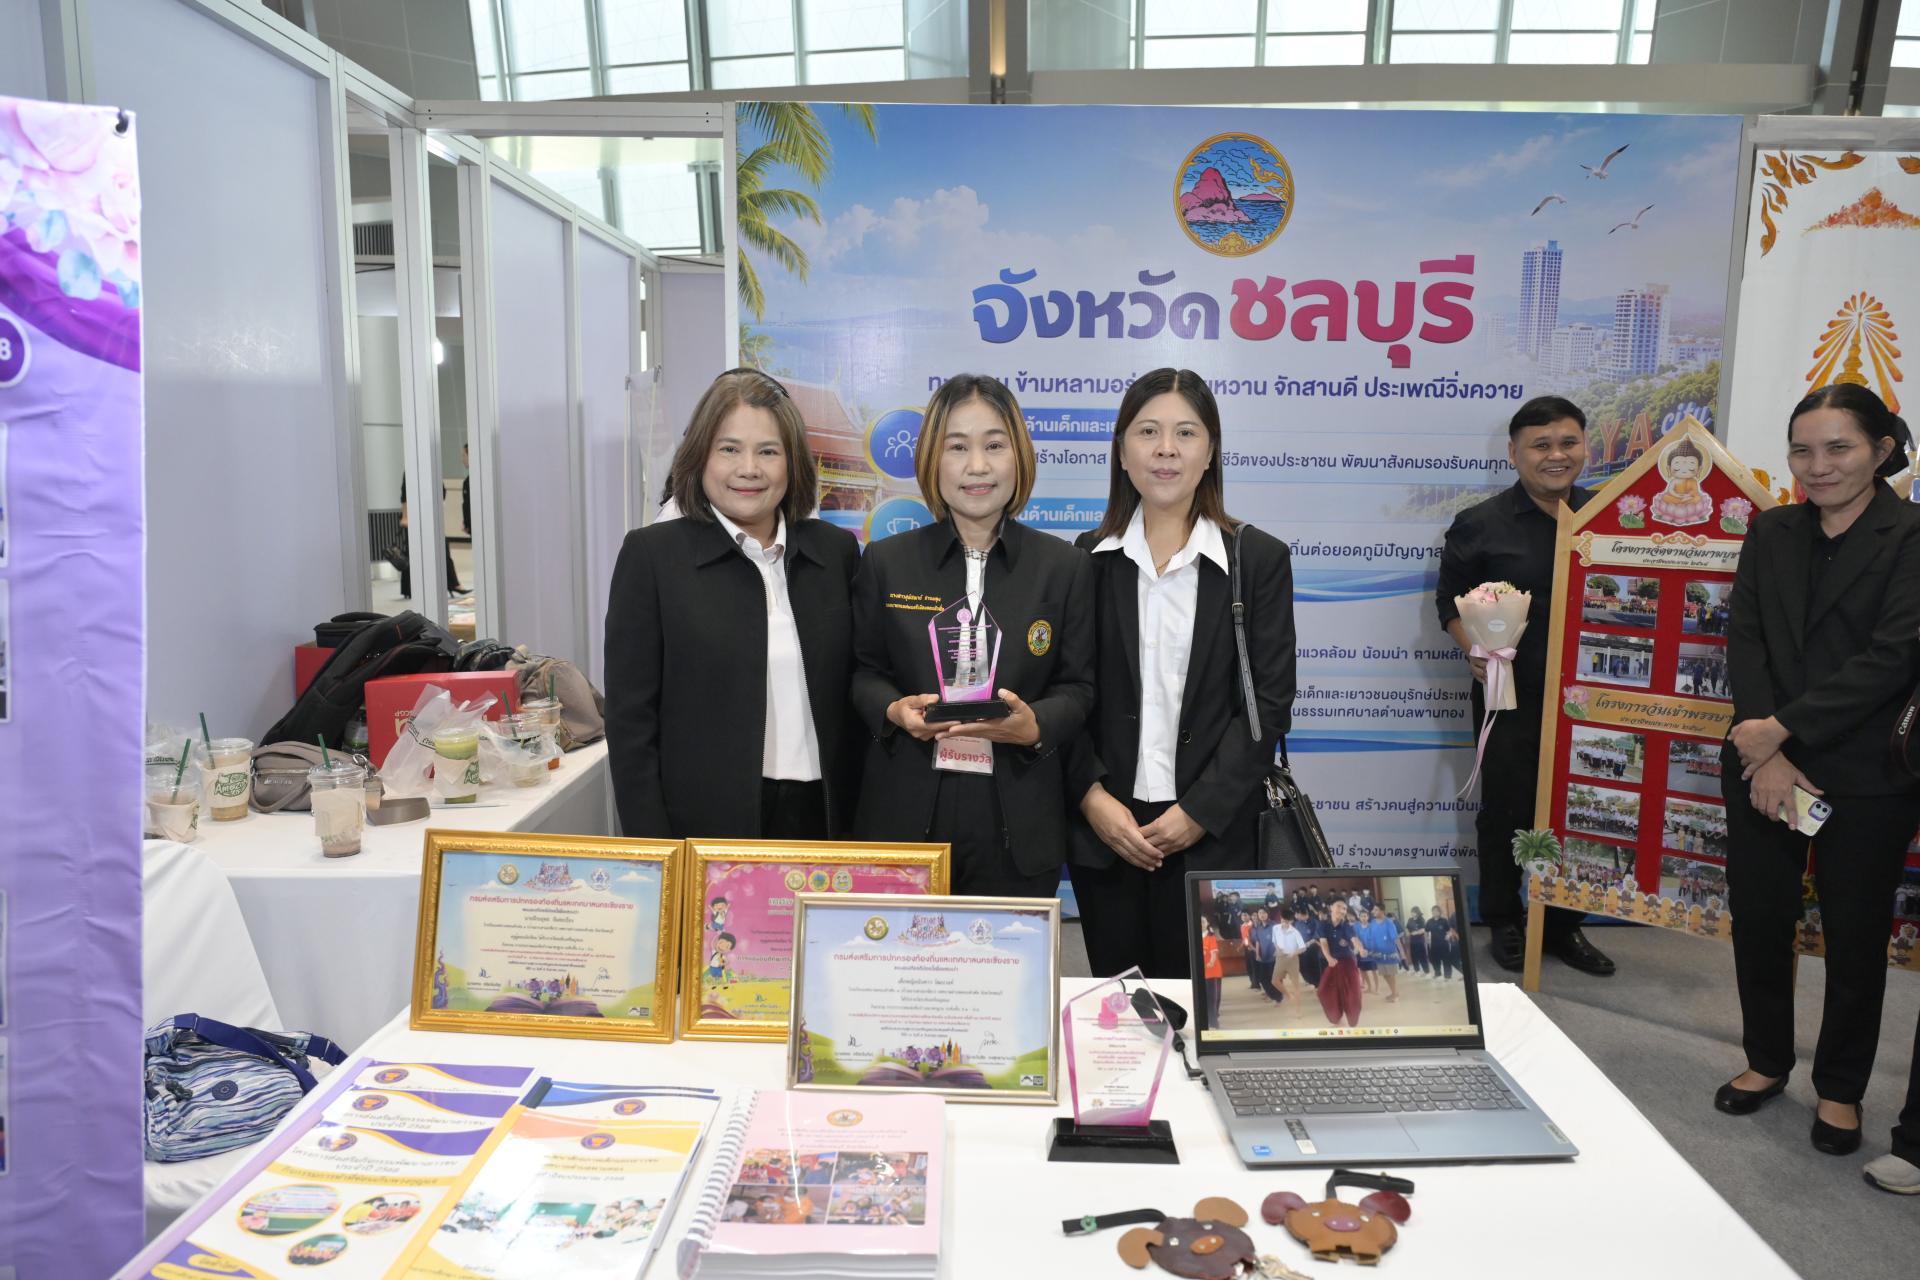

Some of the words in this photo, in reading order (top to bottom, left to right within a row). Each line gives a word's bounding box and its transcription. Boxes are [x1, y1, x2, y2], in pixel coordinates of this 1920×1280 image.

[972, 254, 1475, 369] จังหวัดชลบุรี
[1015, 371, 1137, 394] ข้ามหลามอร่
[1274, 375, 1358, 397] จักสานดี
[1364, 371, 1524, 399] ประเพณีวิ่งควาย
[1222, 452, 1337, 468] ชีวิตของประชาชน
[1289, 539, 1444, 561] ถิ่นต่อยอดภูมิปัญญาส
[1611, 540, 1741, 564] โครงการจัดงานวันมาฆบูช
[1296, 646, 1356, 660] งแวดล้อม
[1414, 647, 1470, 661] ตามหลัก
[1292, 705, 1465, 719] นธรรมเทศบาลตำบลพานทอง
[1898, 705, 1916, 735] Canon
[940, 747, 993, 765] ผู้รับรางวัล
